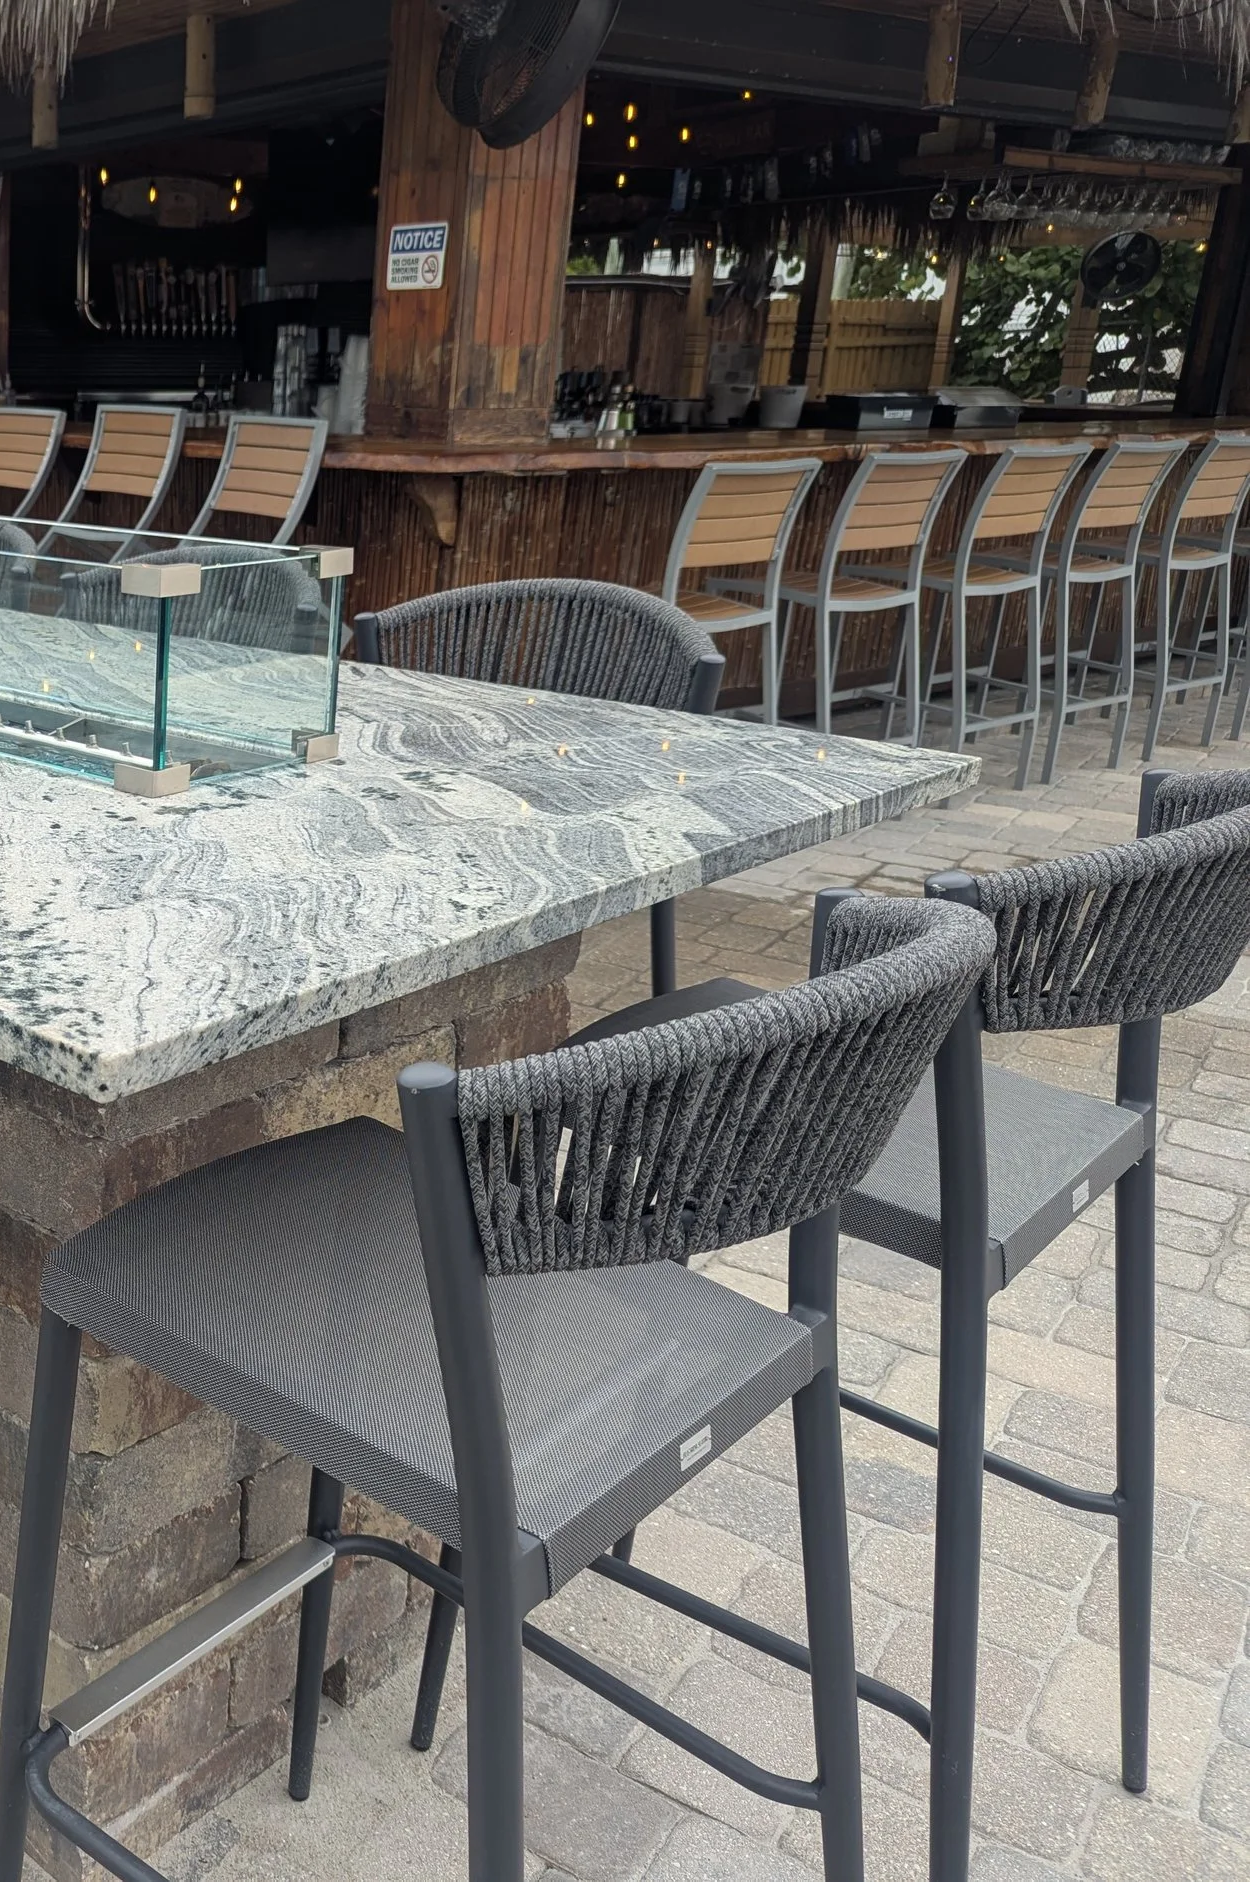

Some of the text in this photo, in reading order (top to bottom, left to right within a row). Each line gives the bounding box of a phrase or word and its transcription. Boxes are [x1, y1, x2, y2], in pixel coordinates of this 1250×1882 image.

[393, 230, 444, 251] NOTICE
[391, 267, 418, 275] SMOKING
[391, 275, 418, 283] ALLOWED
